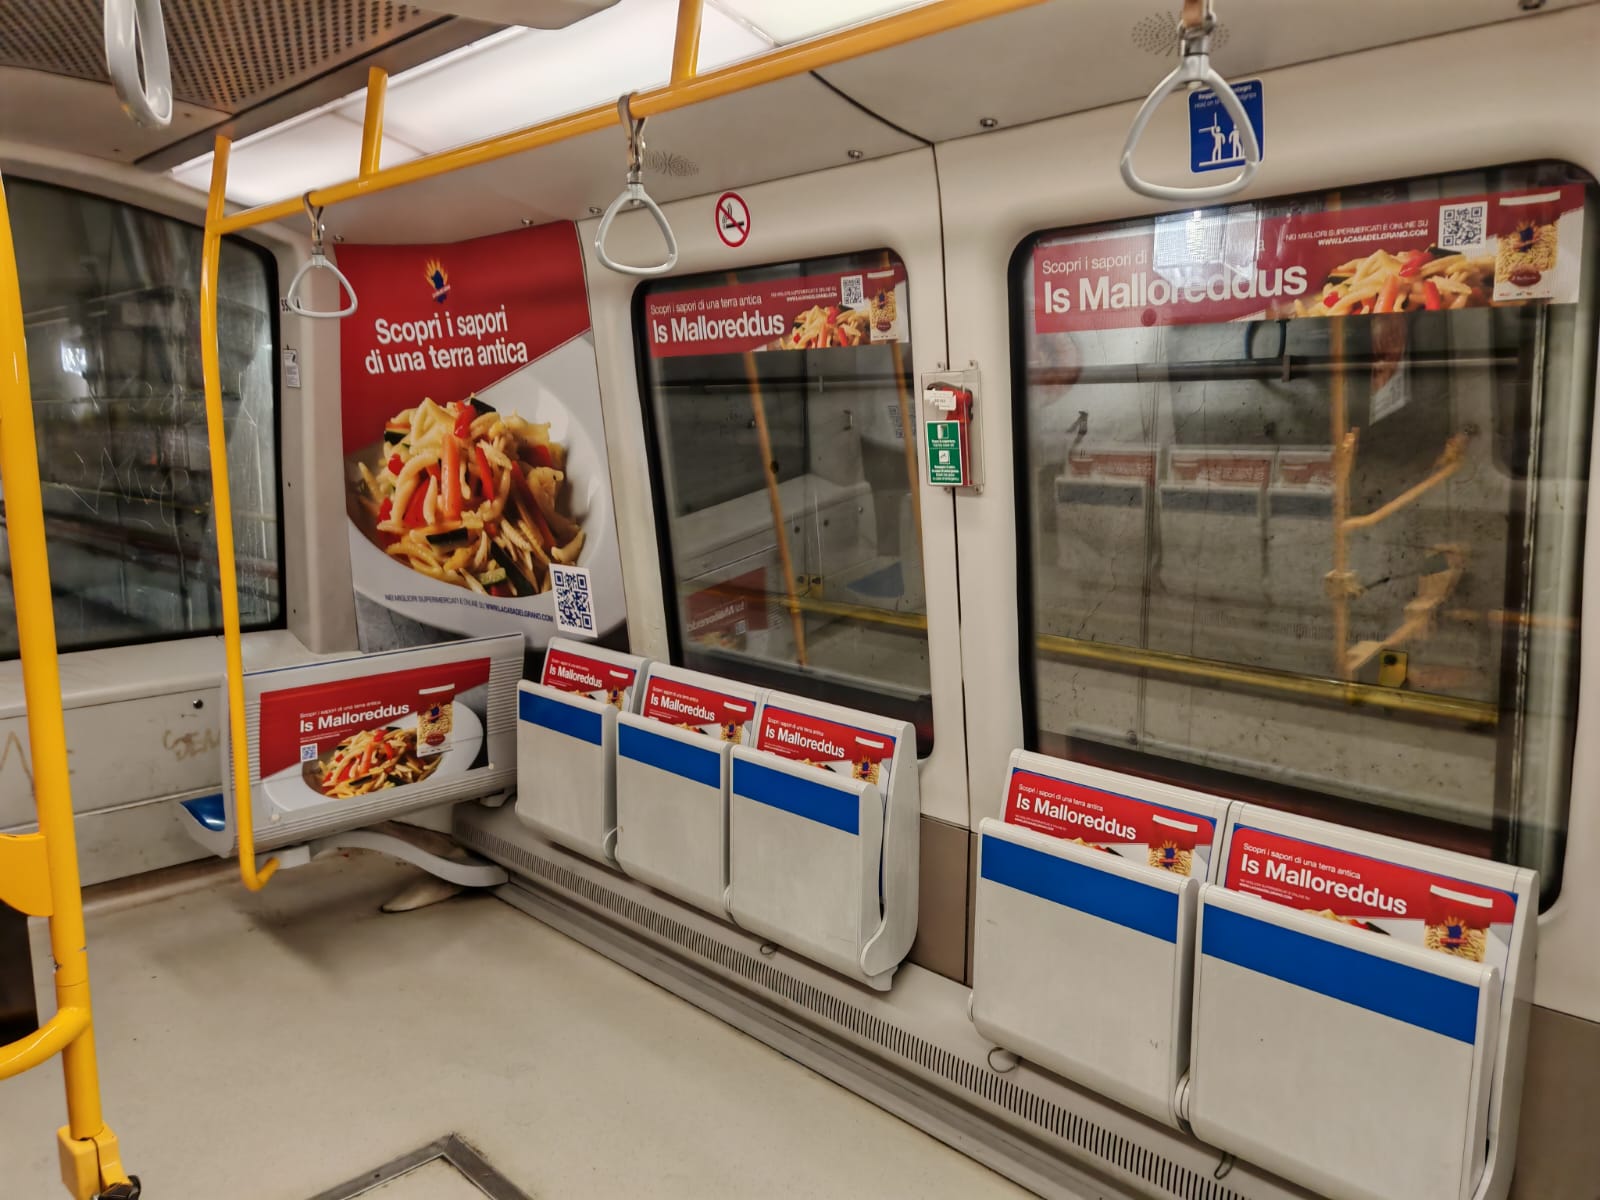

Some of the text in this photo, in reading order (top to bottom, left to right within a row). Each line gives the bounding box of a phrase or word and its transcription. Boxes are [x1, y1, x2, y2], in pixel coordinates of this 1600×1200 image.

[1417, 219, 1429, 228] SU
[1042, 257, 1082, 276] Scopri
[1084, 256, 1088, 271] i
[1091, 254, 1132, 275] sapori
[1132, 250, 1147, 266] di
[650, 303, 672, 316] Scopri
[676, 300, 697, 315] sapori
[698, 299, 705, 310] di
[706, 299, 720, 310] una
[720, 296, 738, 308] terra
[739, 294, 762, 306] antica
[1044, 264, 1308, 314] Is Malloreddus
[375, 304, 508, 347] Scopri i sapori
[653, 310, 785, 343] Is Malloreddus
[365, 337, 528, 374] di una terra antica
[549, 663, 556, 675] Is
[557, 665, 603, 688] Malloreddus
[300, 703, 410, 733] Is Malloreddus
[650, 692, 659, 706] Is
[660, 695, 716, 721] Malloreddus
[765, 724, 775, 739] Is
[777, 727, 845, 758] Malloreddus
[1018, 783, 1036, 794] Scopri
[1039, 789, 1056, 801] sapori
[1055, 793, 1062, 801] di
[1061, 796, 1073, 804] una
[1073, 798, 1086, 808] terra
[1086, 801, 1104, 812] antica
[1016, 793, 1031, 811] Is
[1034, 797, 1137, 840] Malloreddus
[1243, 842, 1267, 857] Scopri
[1270, 850, 1293, 863] sapori
[1294, 855, 1302, 864] di
[1303, 858, 1317, 868] una
[1318, 861, 1337, 874] terra
[1337, 866, 1361, 880] antica
[1241, 853, 1260, 875] Is
[1265, 860, 1407, 915] Malloreddus
